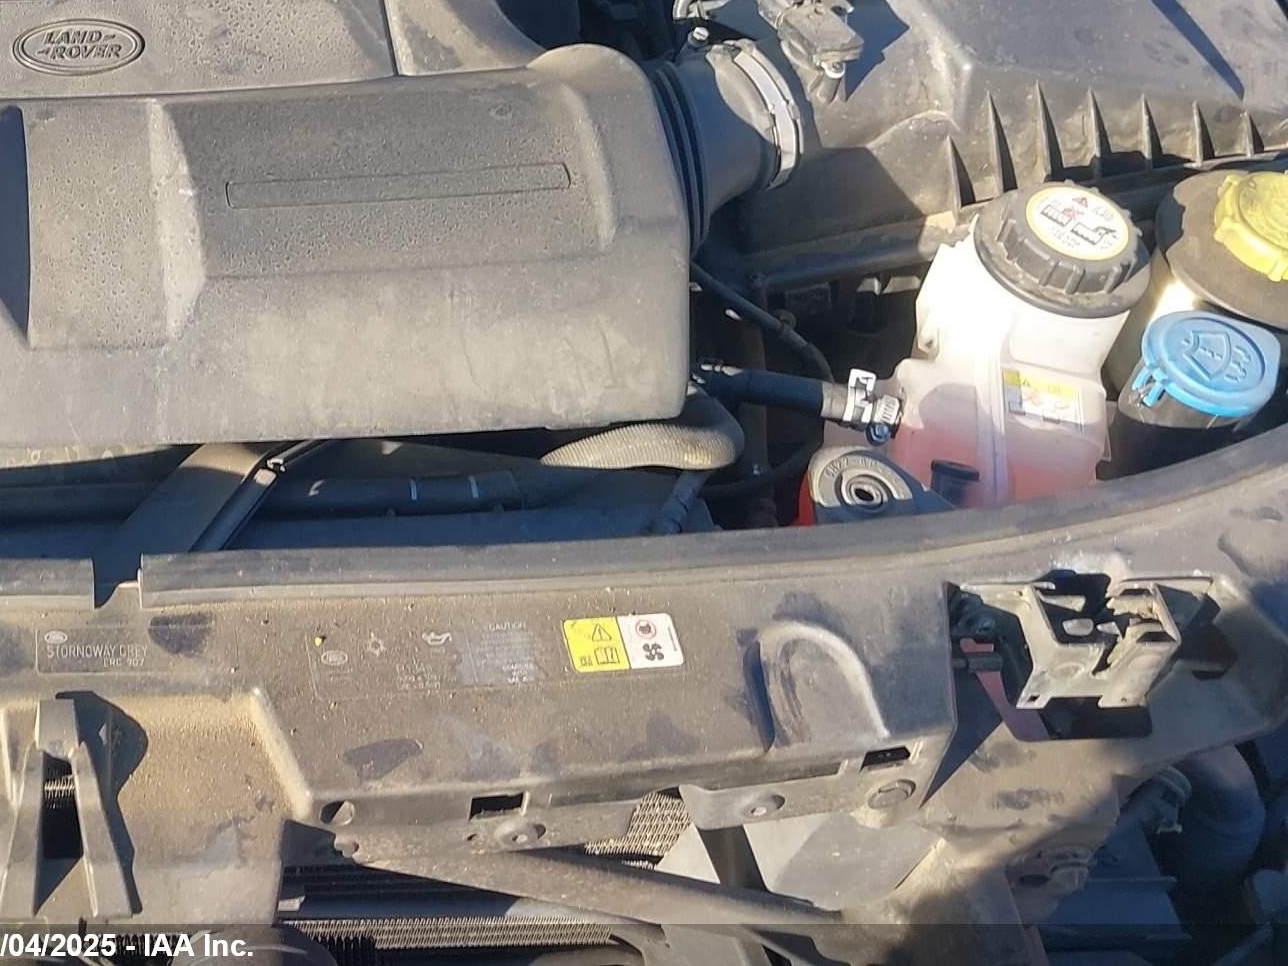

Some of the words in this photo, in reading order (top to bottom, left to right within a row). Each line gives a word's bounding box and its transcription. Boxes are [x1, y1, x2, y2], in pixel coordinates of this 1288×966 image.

[44, 30, 103, 45] LAND
[50, 44, 123, 60] ROVER
[46, 643, 116, 658] STORNOWAY
